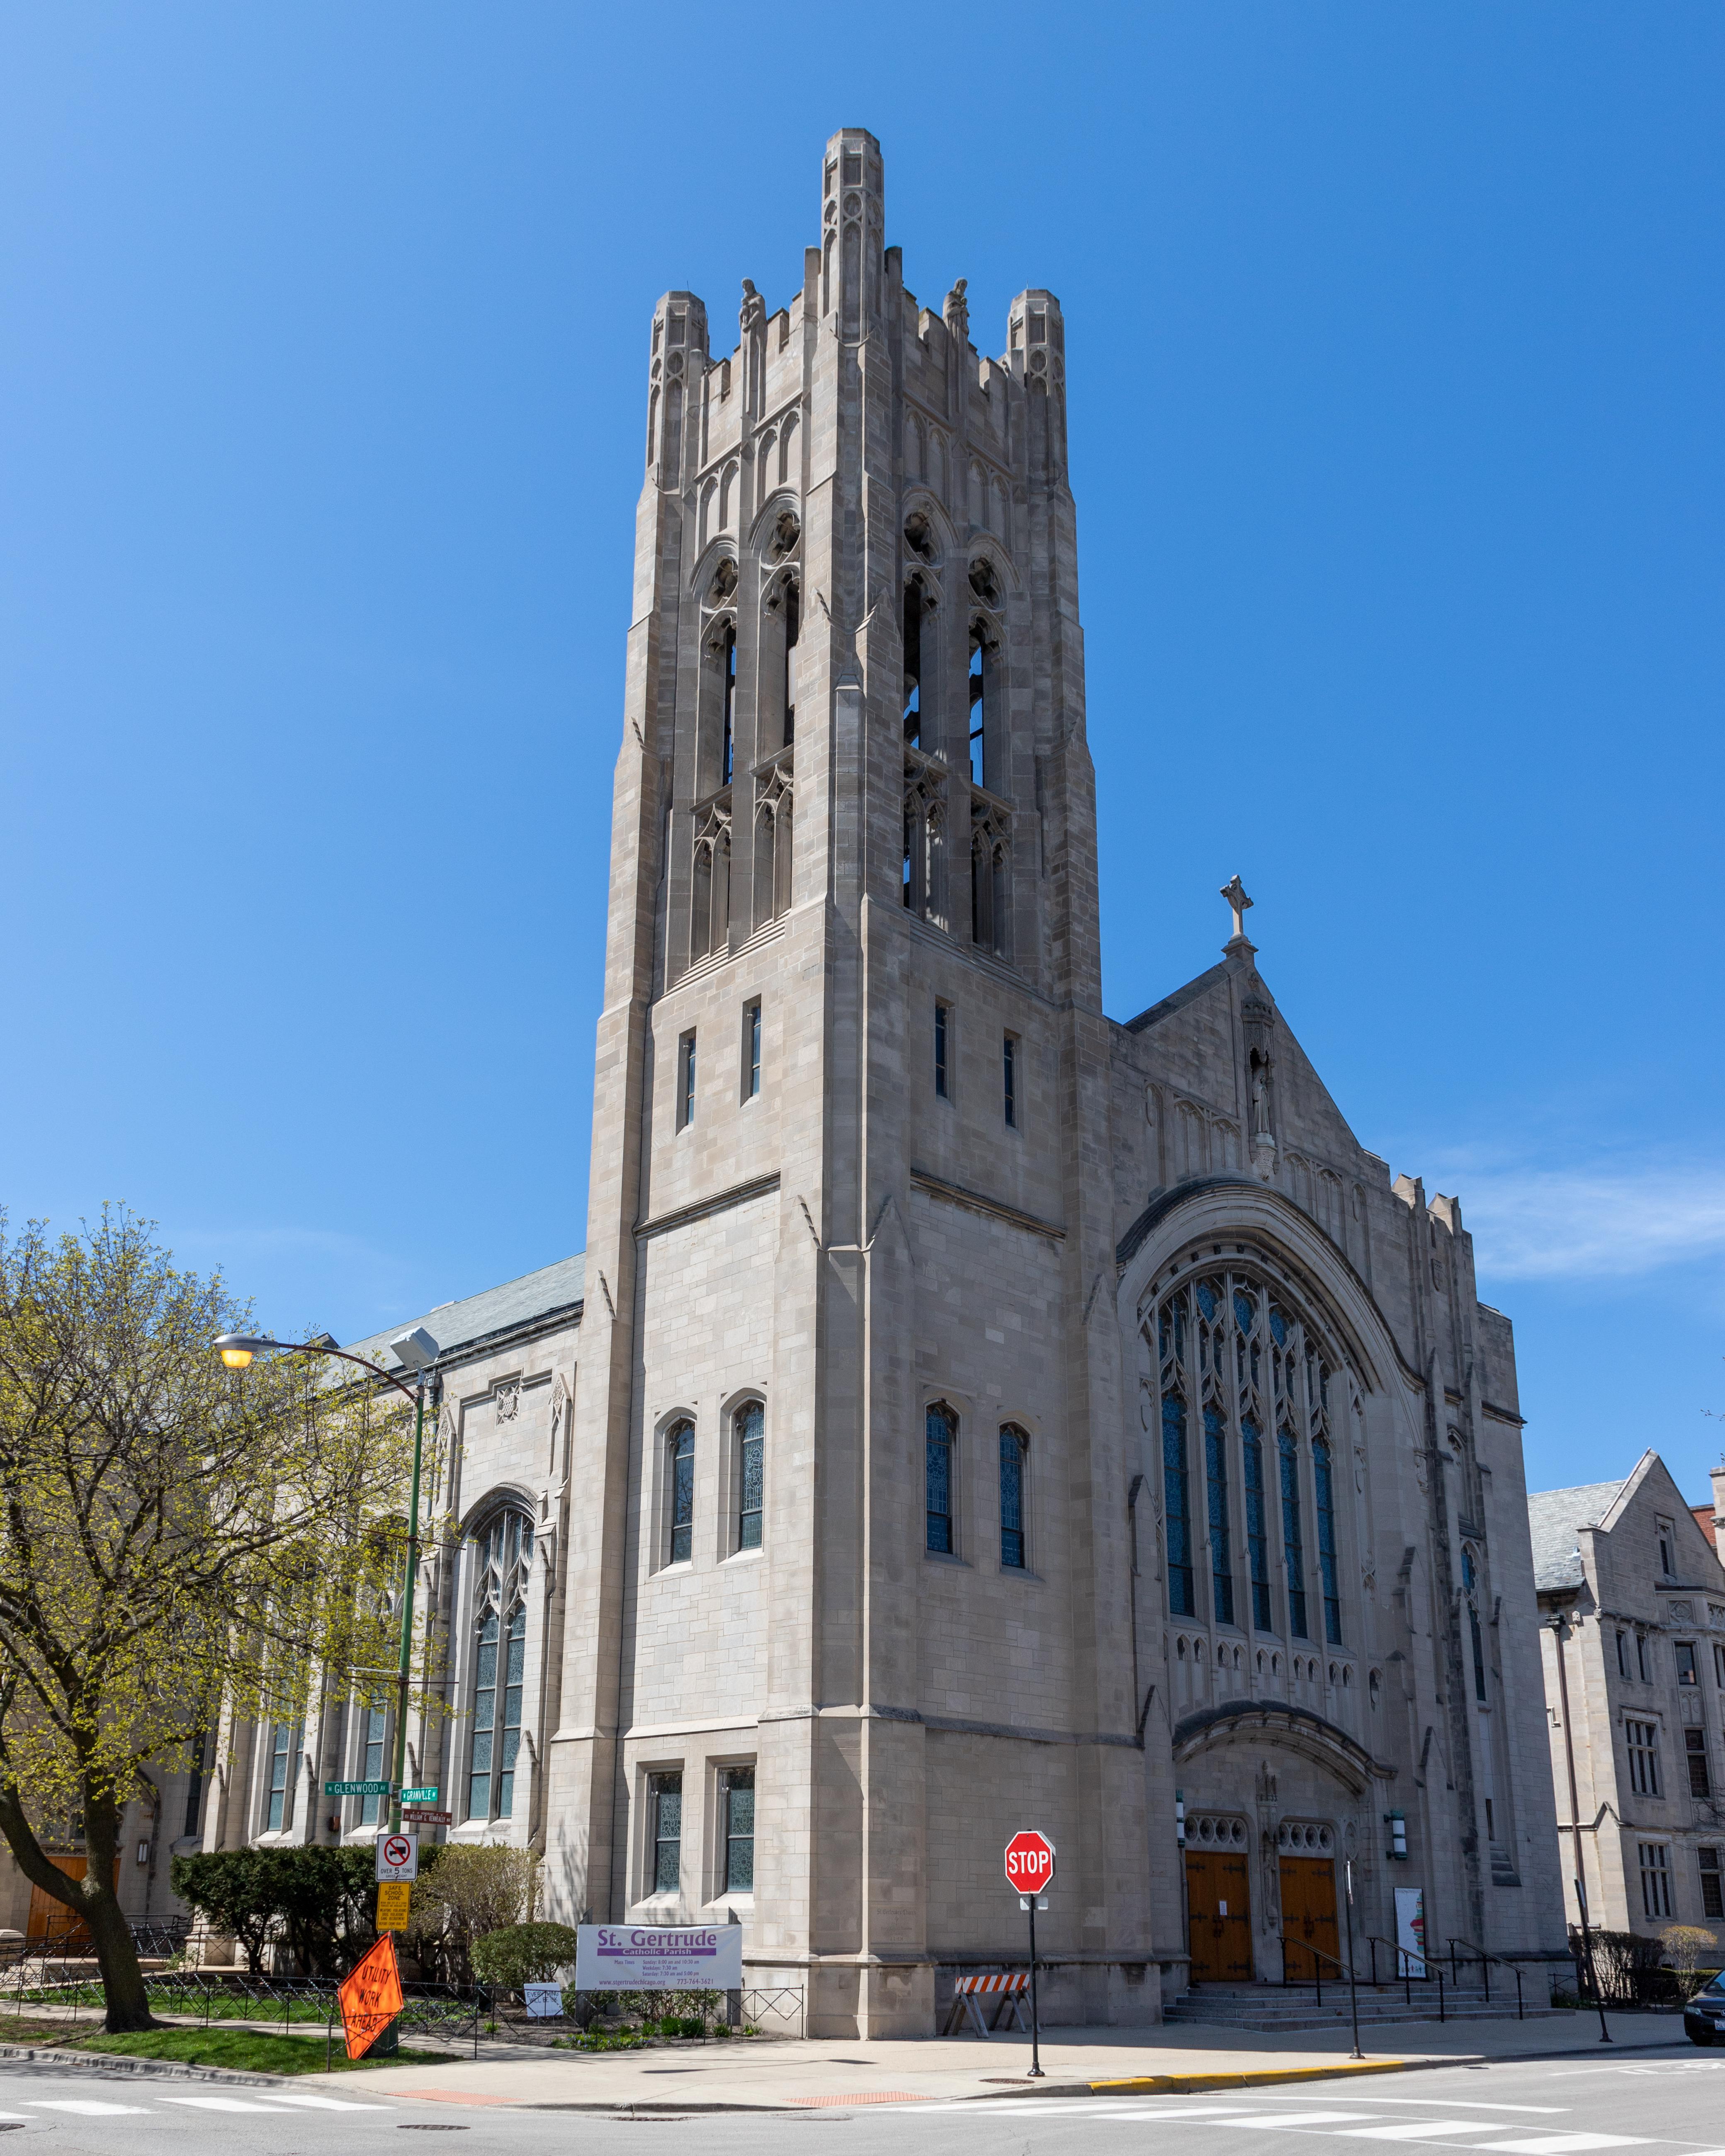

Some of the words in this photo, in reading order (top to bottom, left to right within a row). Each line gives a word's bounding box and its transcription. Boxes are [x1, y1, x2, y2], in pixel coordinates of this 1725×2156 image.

[334, 1783, 378, 1794] GLENWOOD
[407, 1789, 431, 1801] GRANVILLE
[1008, 1851, 1049, 1874] STOP
[598, 1929, 622, 1946] St.
[631, 1930, 717, 1947] Gertrude
[362, 1964, 392, 1984] UTILITY
[359, 1989, 381, 2008] WORK
[351, 2012, 377, 2032] AHEAD
